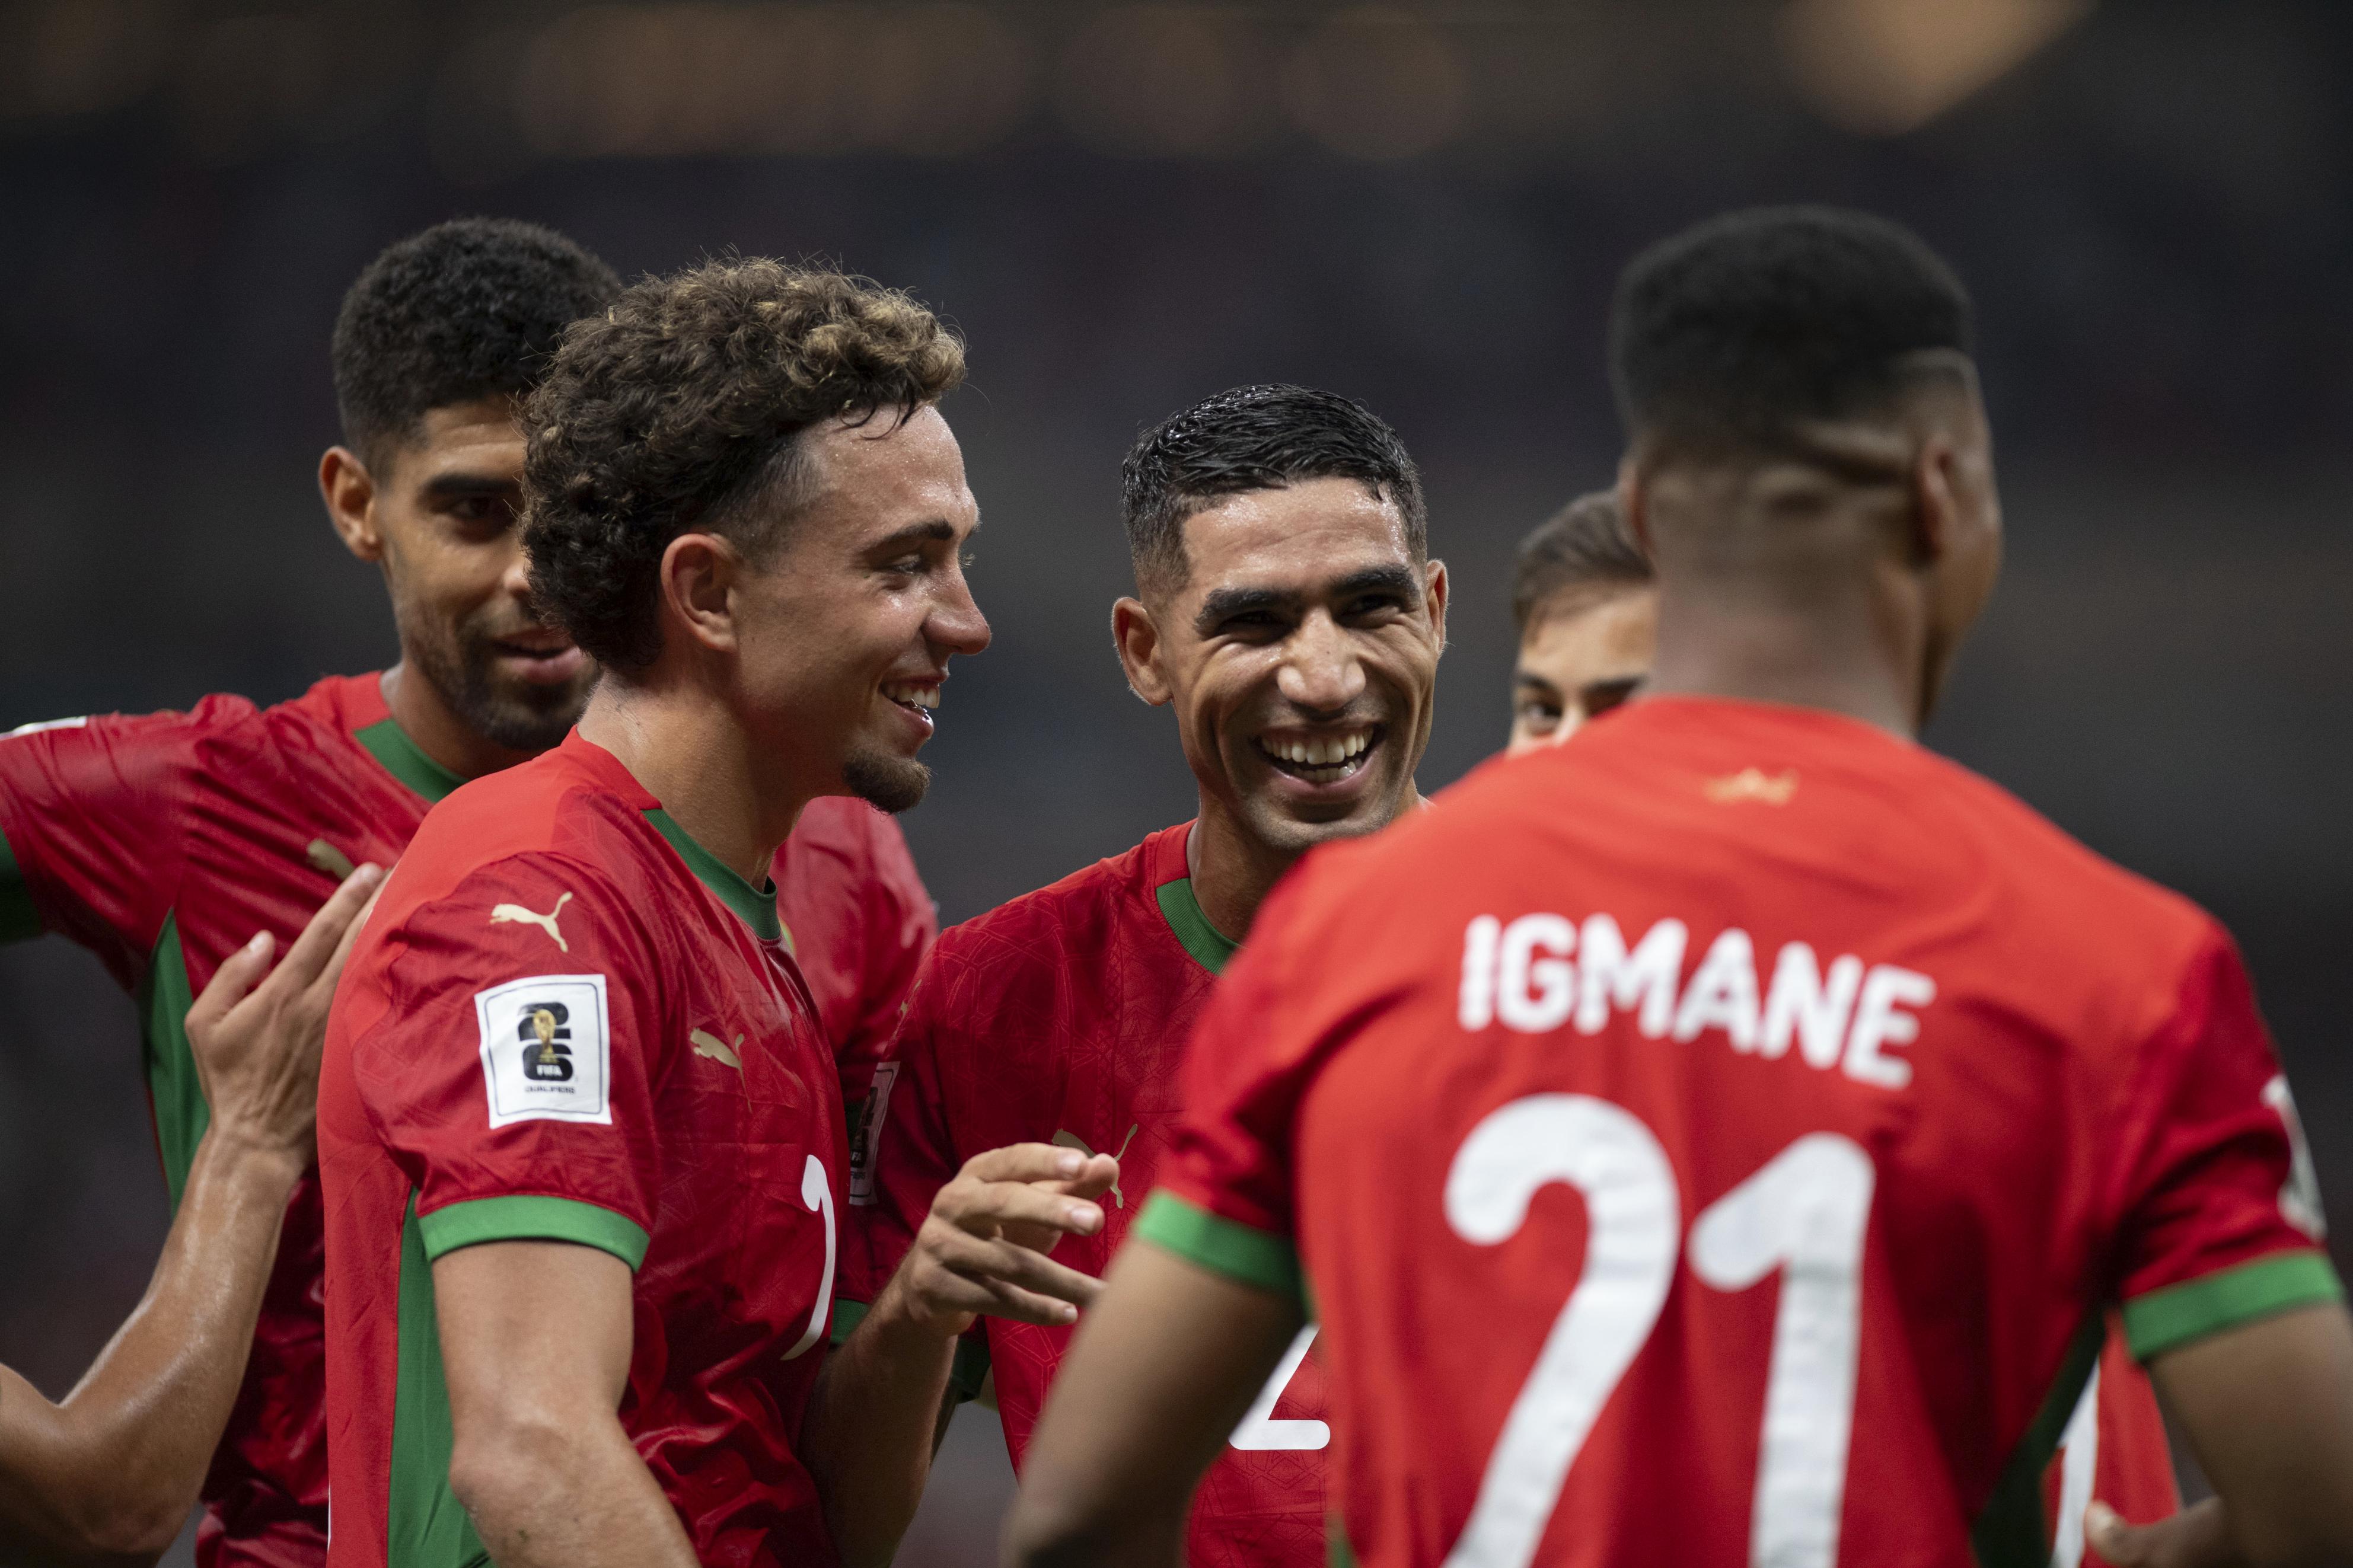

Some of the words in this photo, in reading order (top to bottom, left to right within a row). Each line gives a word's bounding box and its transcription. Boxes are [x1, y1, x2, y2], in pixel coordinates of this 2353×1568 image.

[537, 1064, 563, 1077] FIFA
[1458, 912, 1936, 1089] IGMANE
[1442, 1092, 1875, 1568] 21
